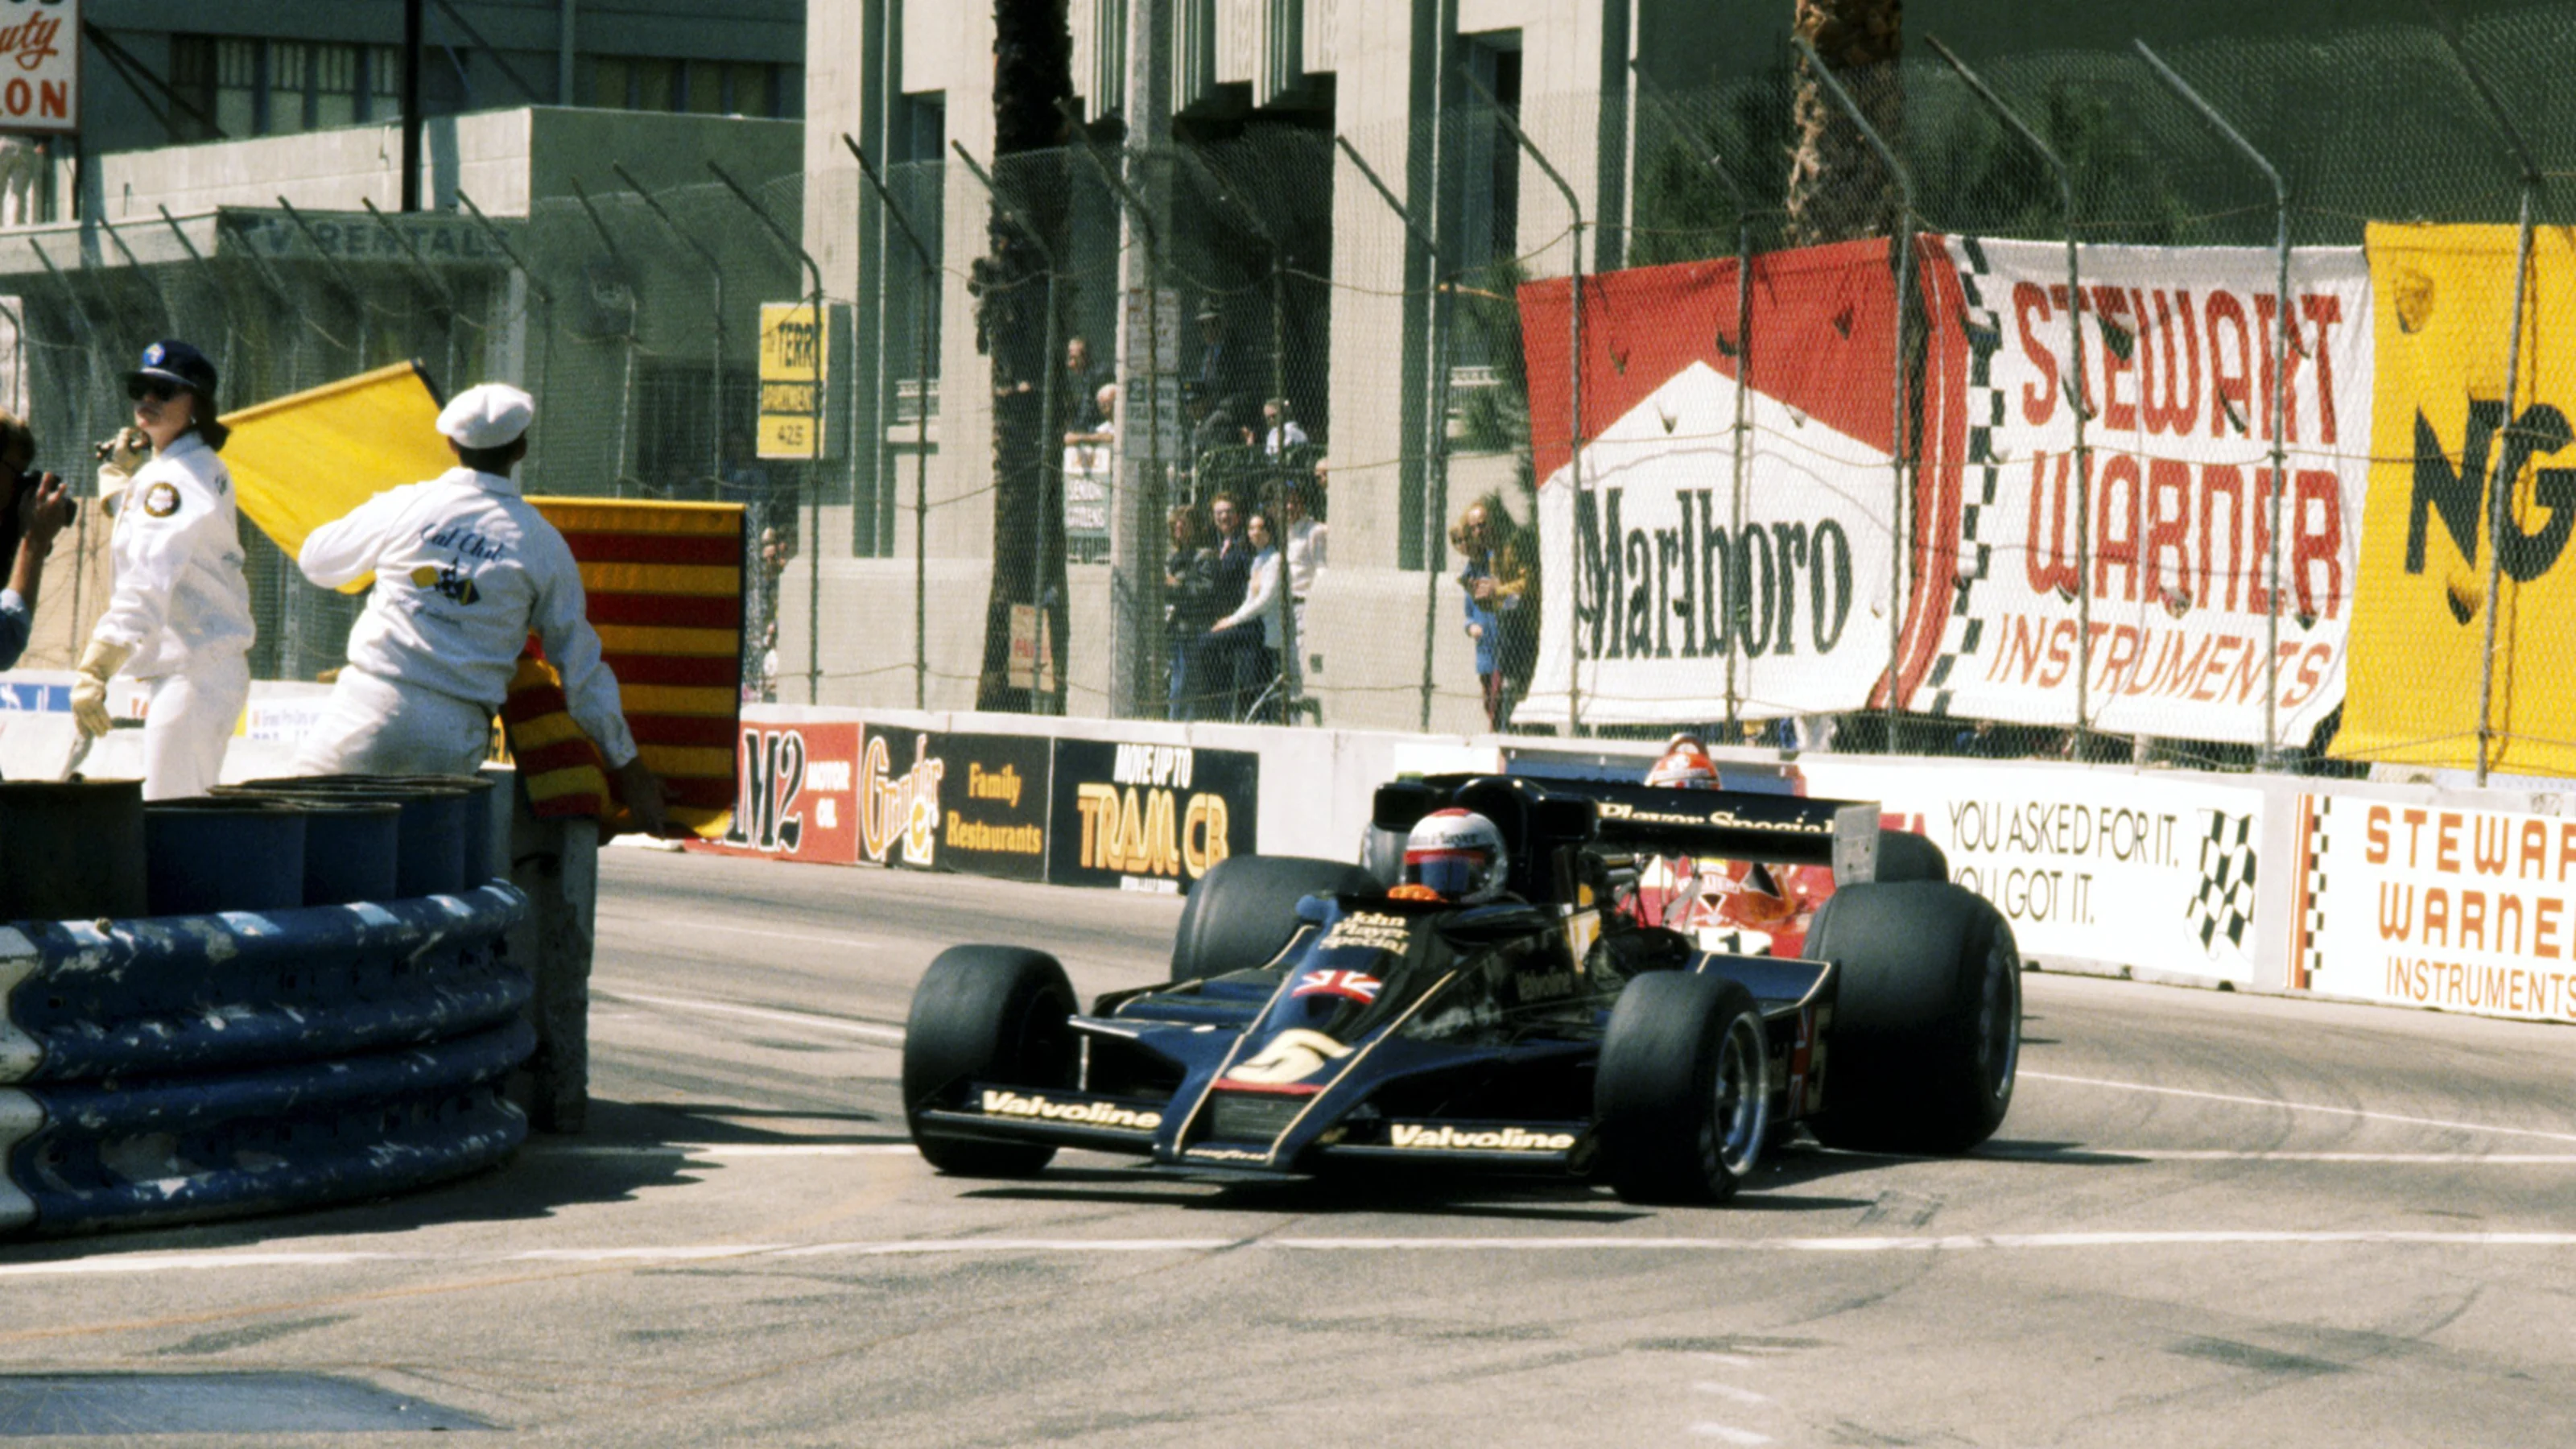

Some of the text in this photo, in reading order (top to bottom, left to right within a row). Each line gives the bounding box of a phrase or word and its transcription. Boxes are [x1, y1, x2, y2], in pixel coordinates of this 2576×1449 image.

[778, 322, 823, 368] TERR
[2013, 281, 2343, 445] STEWART
[2025, 450, 2343, 621] WARNER
[1578, 486, 1853, 662] Marlboro
[1985, 613, 2333, 708] INSTRUMENTS
[806, 761, 850, 791] MOTOR
[969, 762, 1022, 807] Family
[1113, 743, 1193, 790] MOVE UP TO
[946, 810, 1042, 855] Restaurants
[1077, 782, 1228, 879] TRAM CB
[1949, 800, 2001, 853] YOU
[2006, 801, 2092, 856] ASKED
[2098, 807, 2149, 865] FOR
[1342, 910, 1406, 928] John
[2004, 867, 2062, 922] GOT
[1318, 933, 1410, 956] Special
[1331, 921, 1410, 940] Player
[2379, 881, 2576, 963] WARNE
[2386, 955, 2576, 1020] INSTRUMENTS
[1227, 1028, 1356, 1084] 5
[982, 1090, 1162, 1128] Valvoline
[1390, 1124, 1575, 1150] Valvoline
